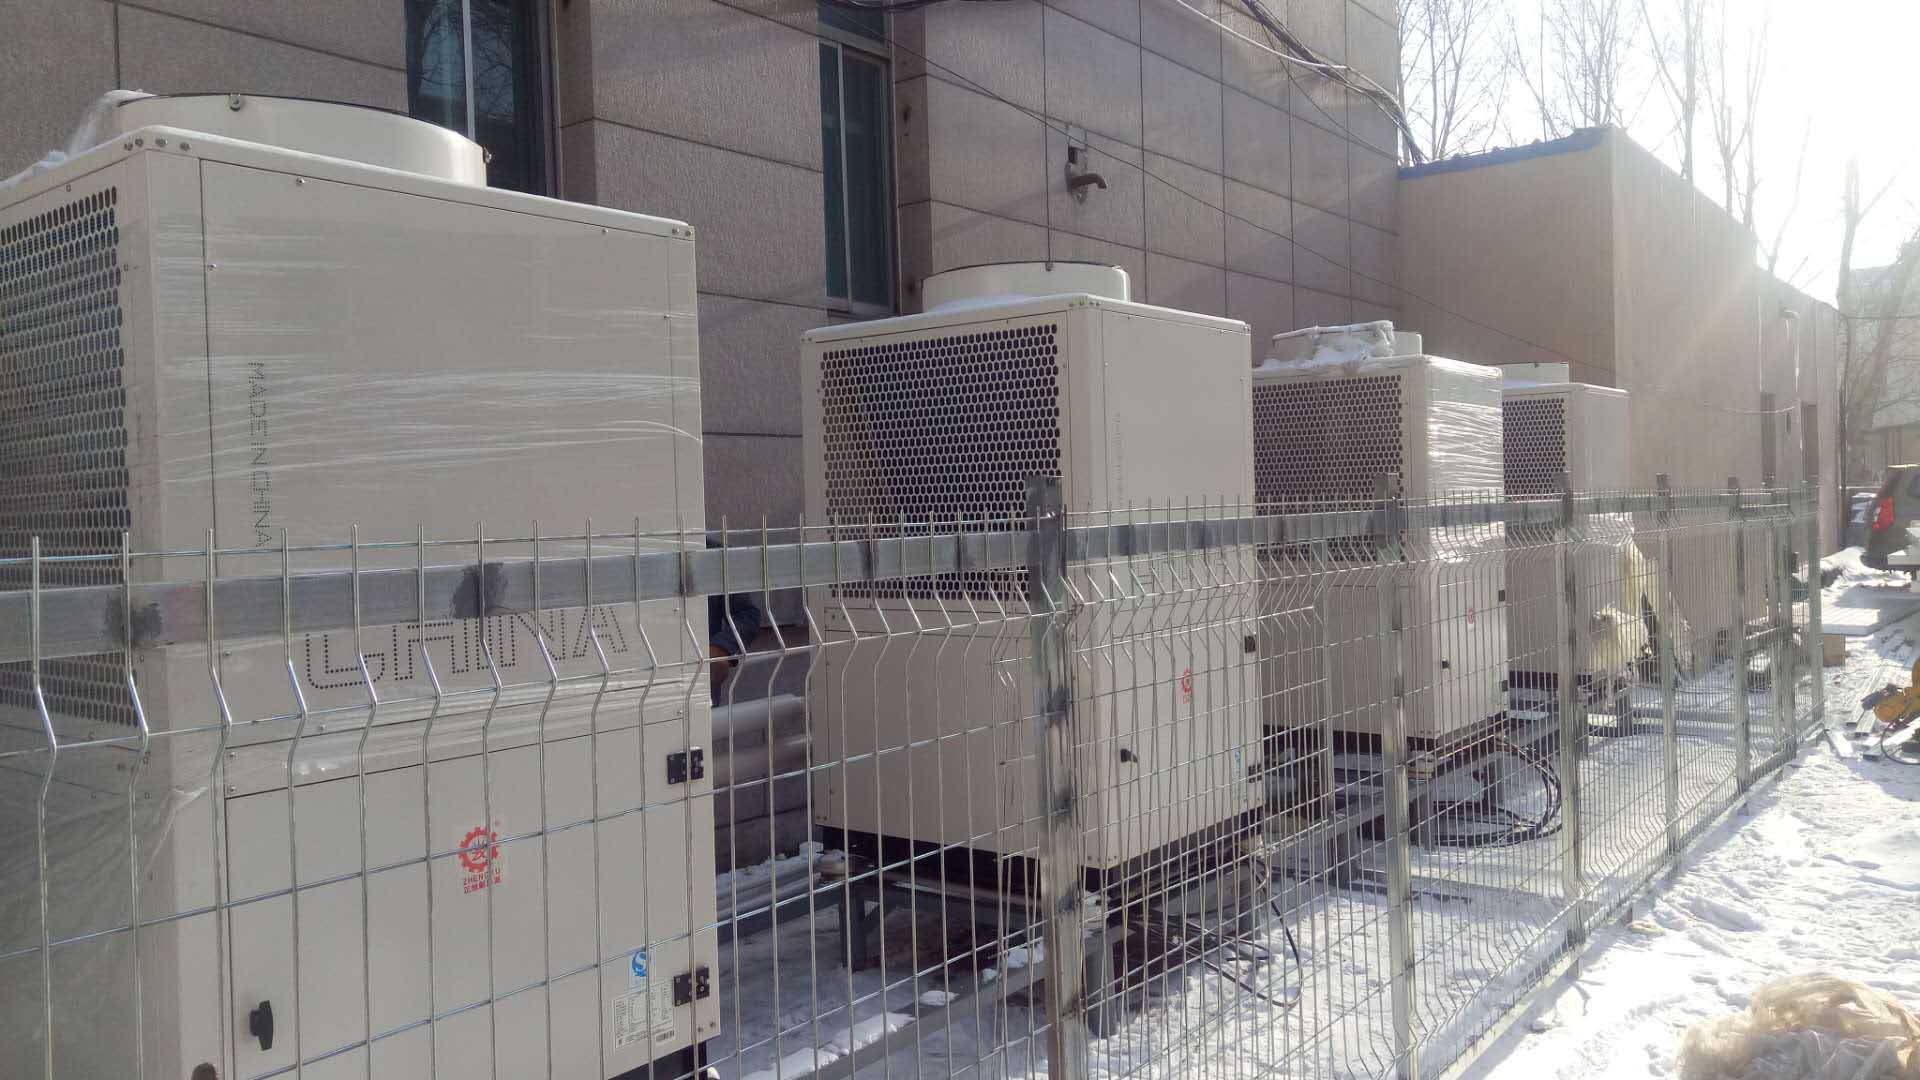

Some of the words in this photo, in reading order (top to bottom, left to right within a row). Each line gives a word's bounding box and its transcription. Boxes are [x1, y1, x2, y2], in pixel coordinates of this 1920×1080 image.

[249, 362, 268, 437] MADE
[250, 443, 269, 465] IN
[252, 471, 273, 548] CHINA
